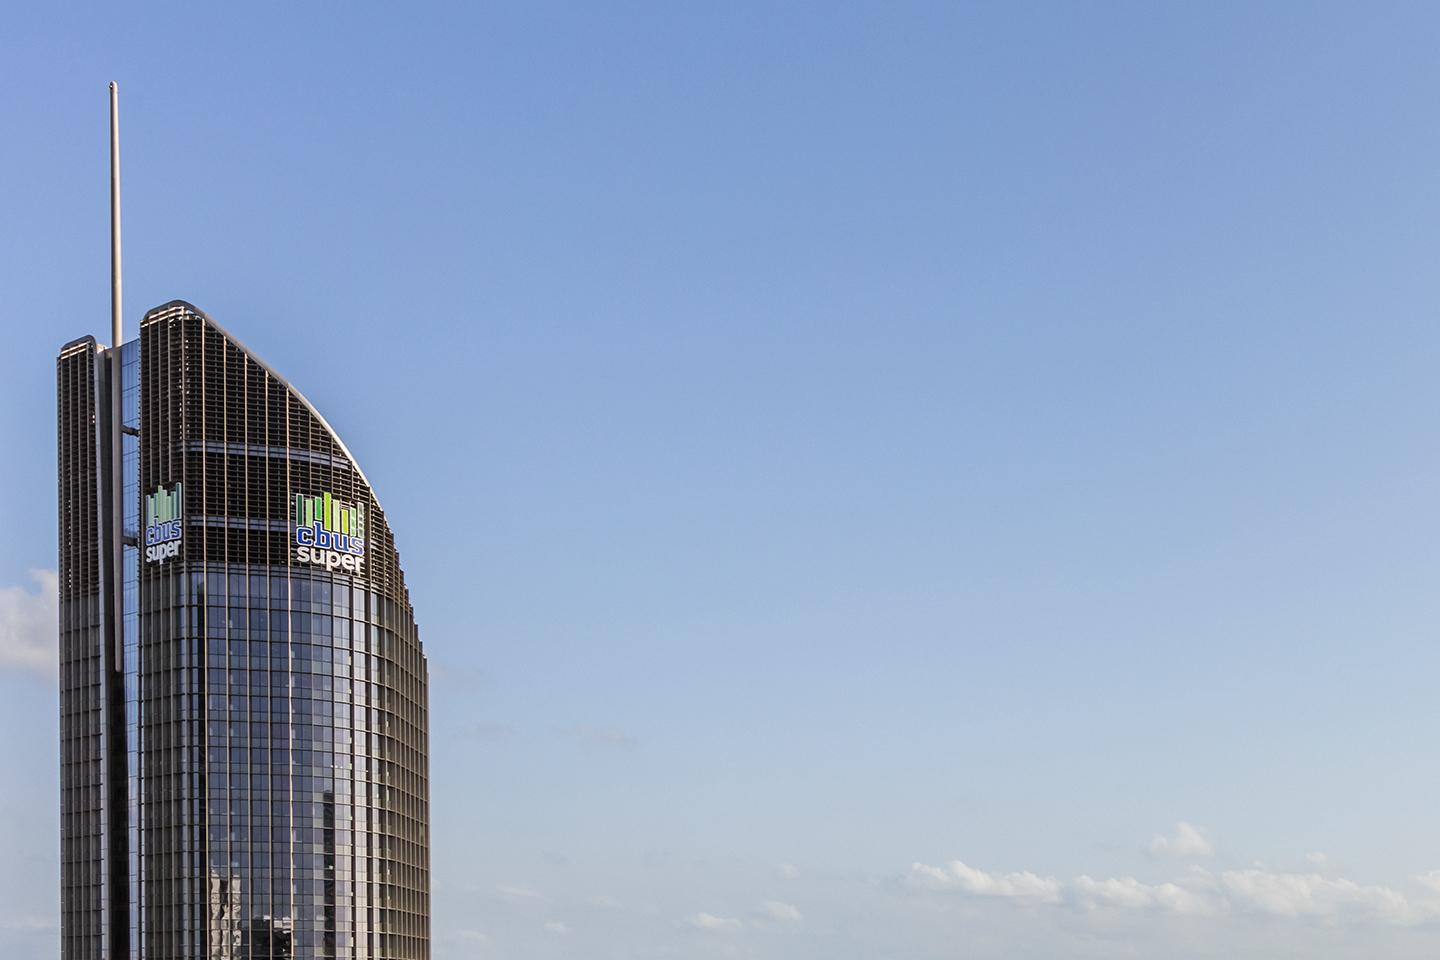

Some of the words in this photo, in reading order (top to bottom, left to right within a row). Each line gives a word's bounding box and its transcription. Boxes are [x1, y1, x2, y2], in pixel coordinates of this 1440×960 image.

[146, 518, 182, 546] cbus
[296, 520, 364, 556] cbus
[146, 540, 182, 565] super
[296, 546, 364, 577] super
